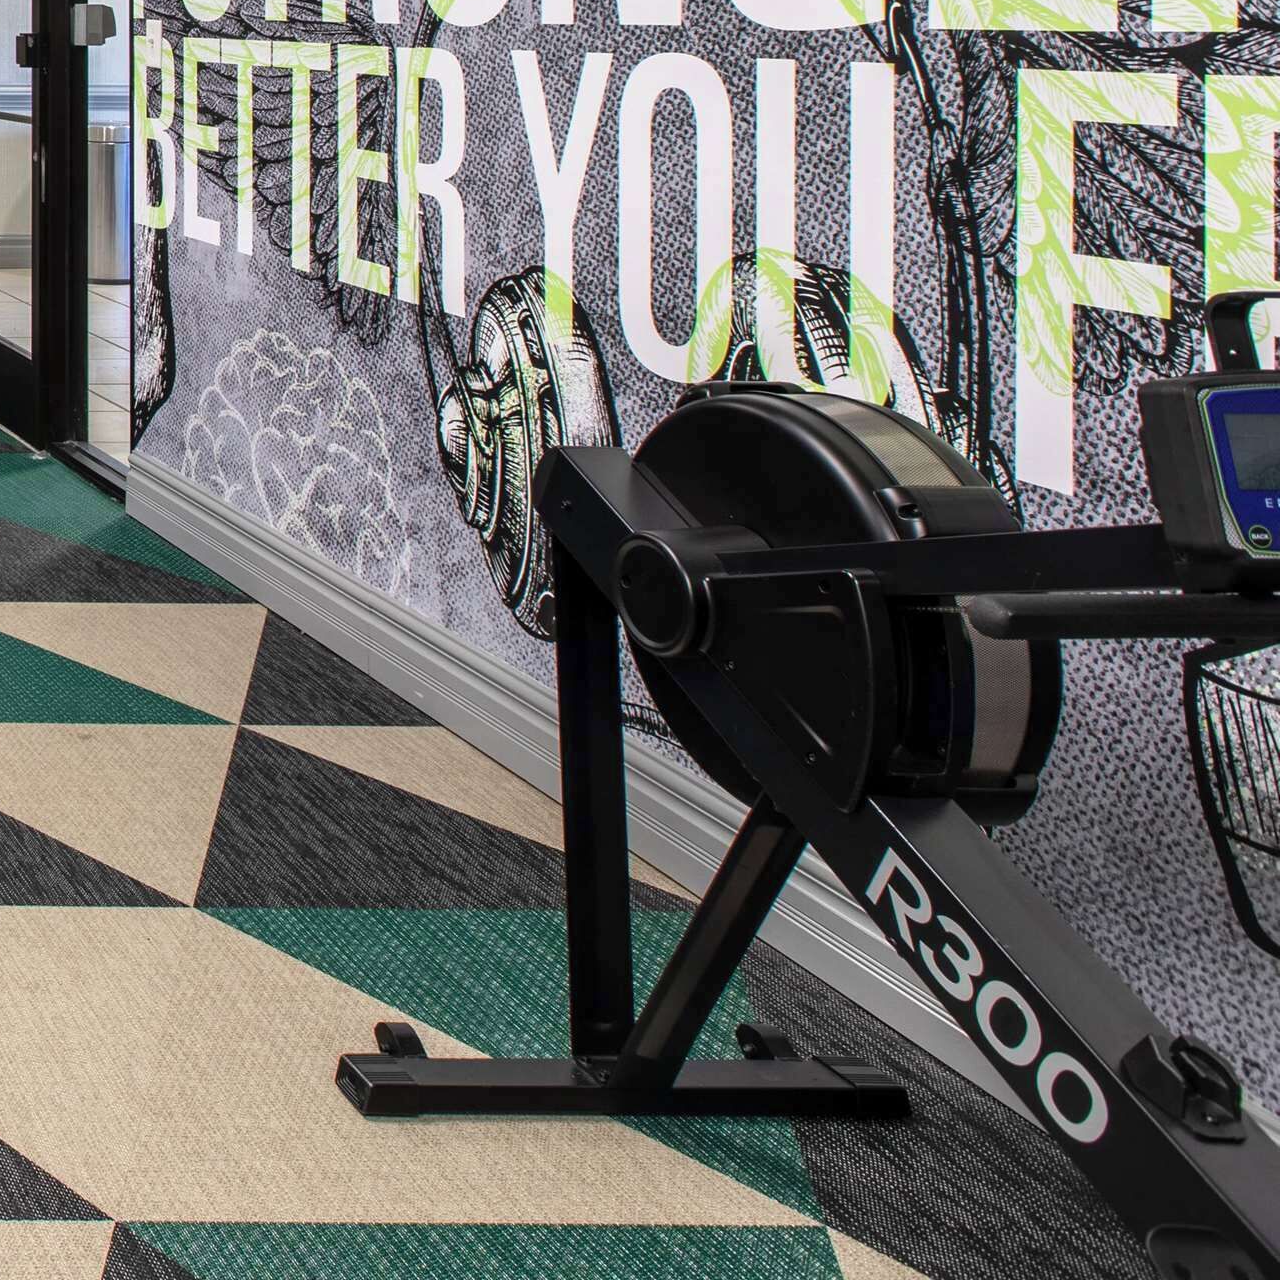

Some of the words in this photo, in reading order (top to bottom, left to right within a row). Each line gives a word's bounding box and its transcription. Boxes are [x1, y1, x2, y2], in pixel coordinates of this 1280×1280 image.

[133, 36, 467, 319] BETTER
[510, 49, 896, 408] YOU
[864, 846, 1109, 1144] R300
